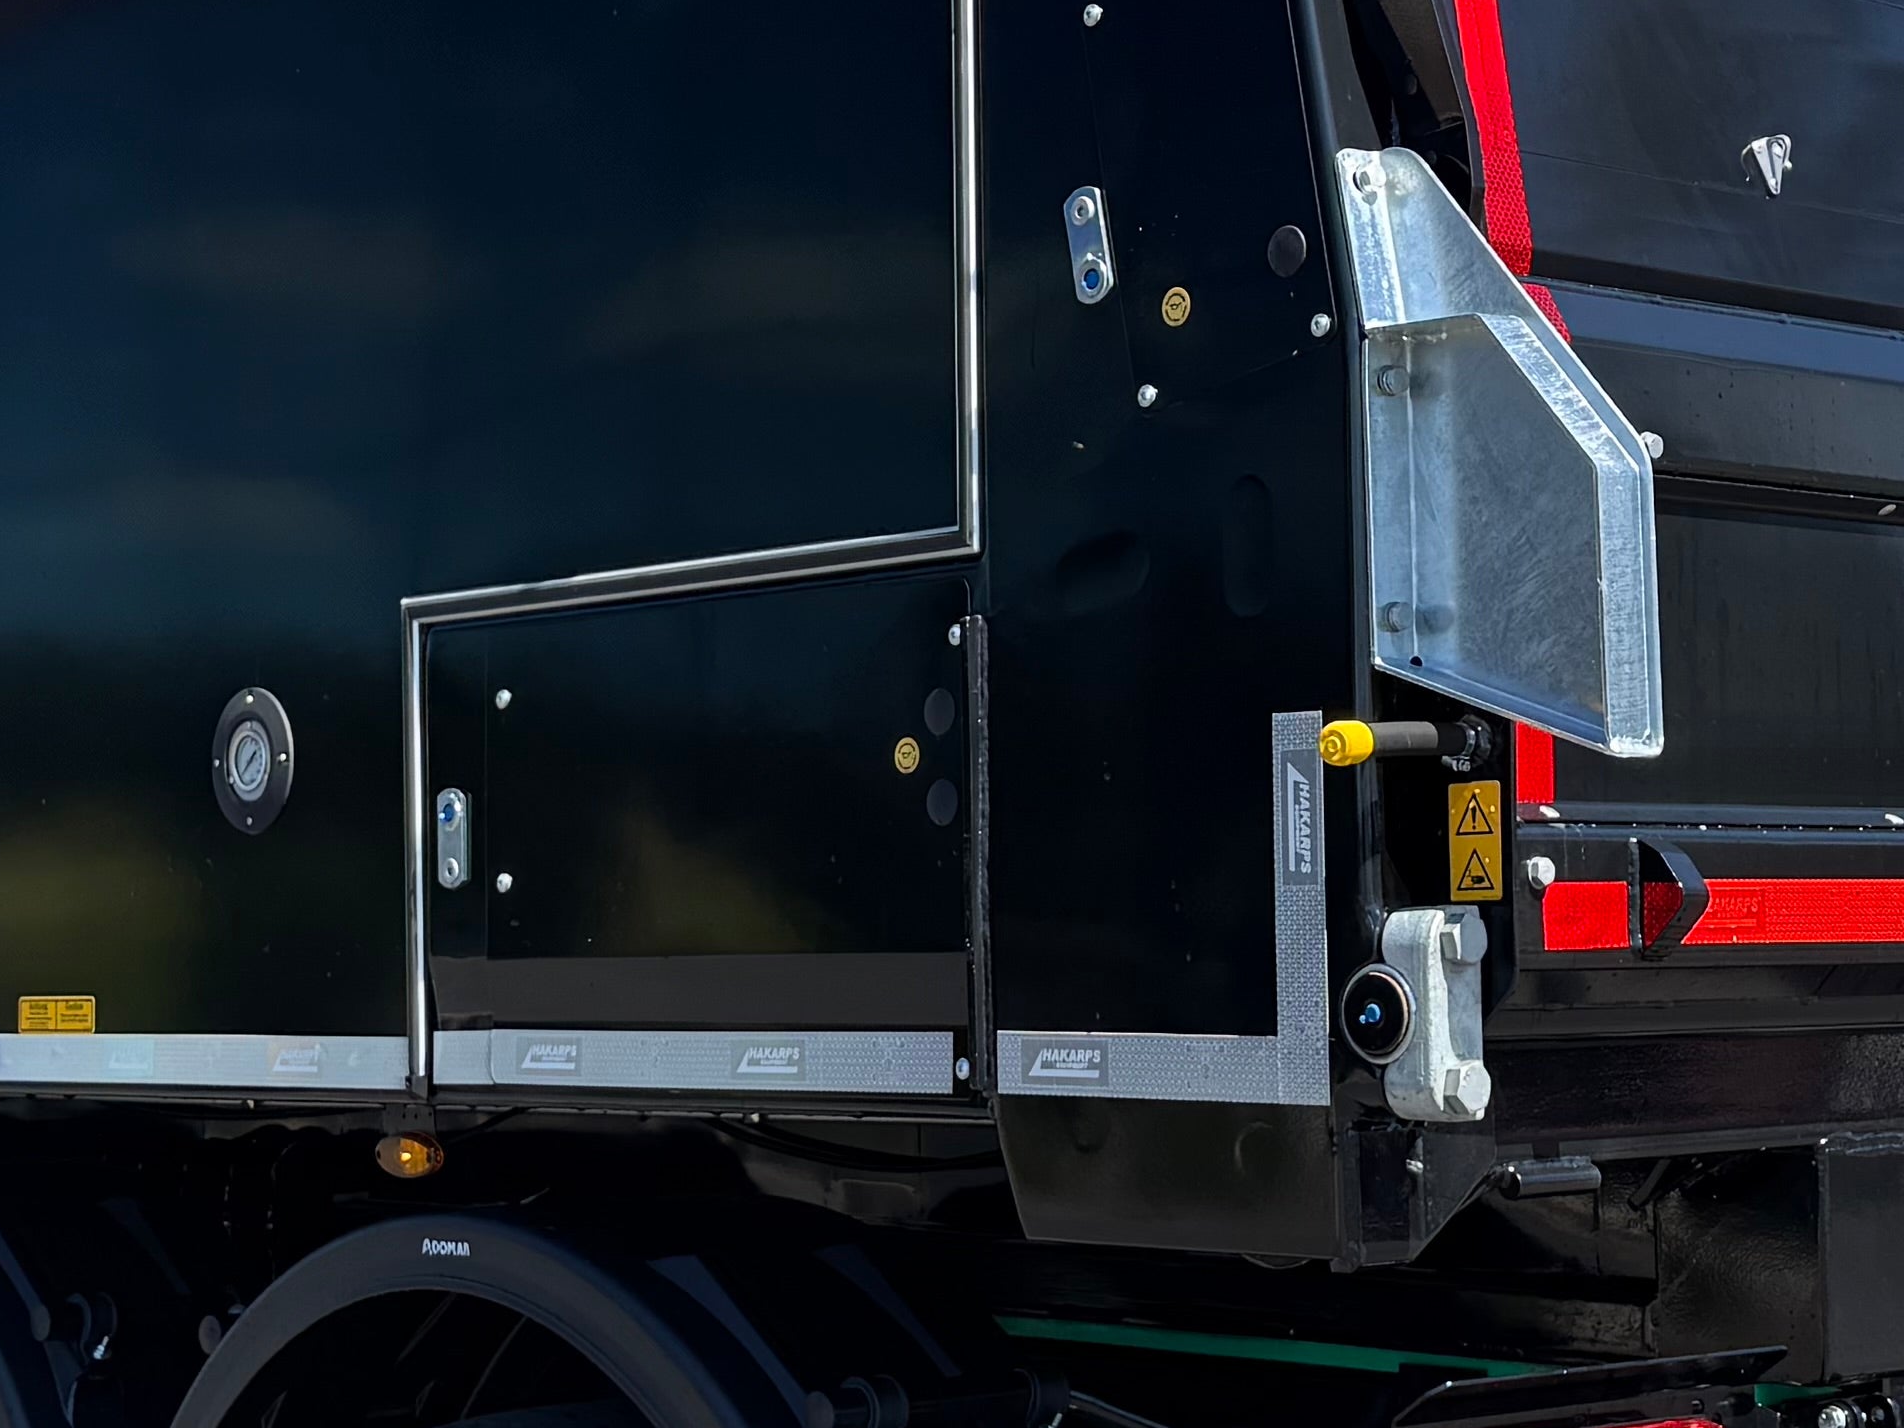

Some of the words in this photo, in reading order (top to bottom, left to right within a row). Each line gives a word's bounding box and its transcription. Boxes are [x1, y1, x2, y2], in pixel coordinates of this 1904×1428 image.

[1299, 783, 1313, 874] HAKARPS
[531, 1043, 577, 1057] HAKARPS
[748, 1045, 800, 1060] HAKARPS
[1042, 1047, 1101, 1063] HAKARPS
